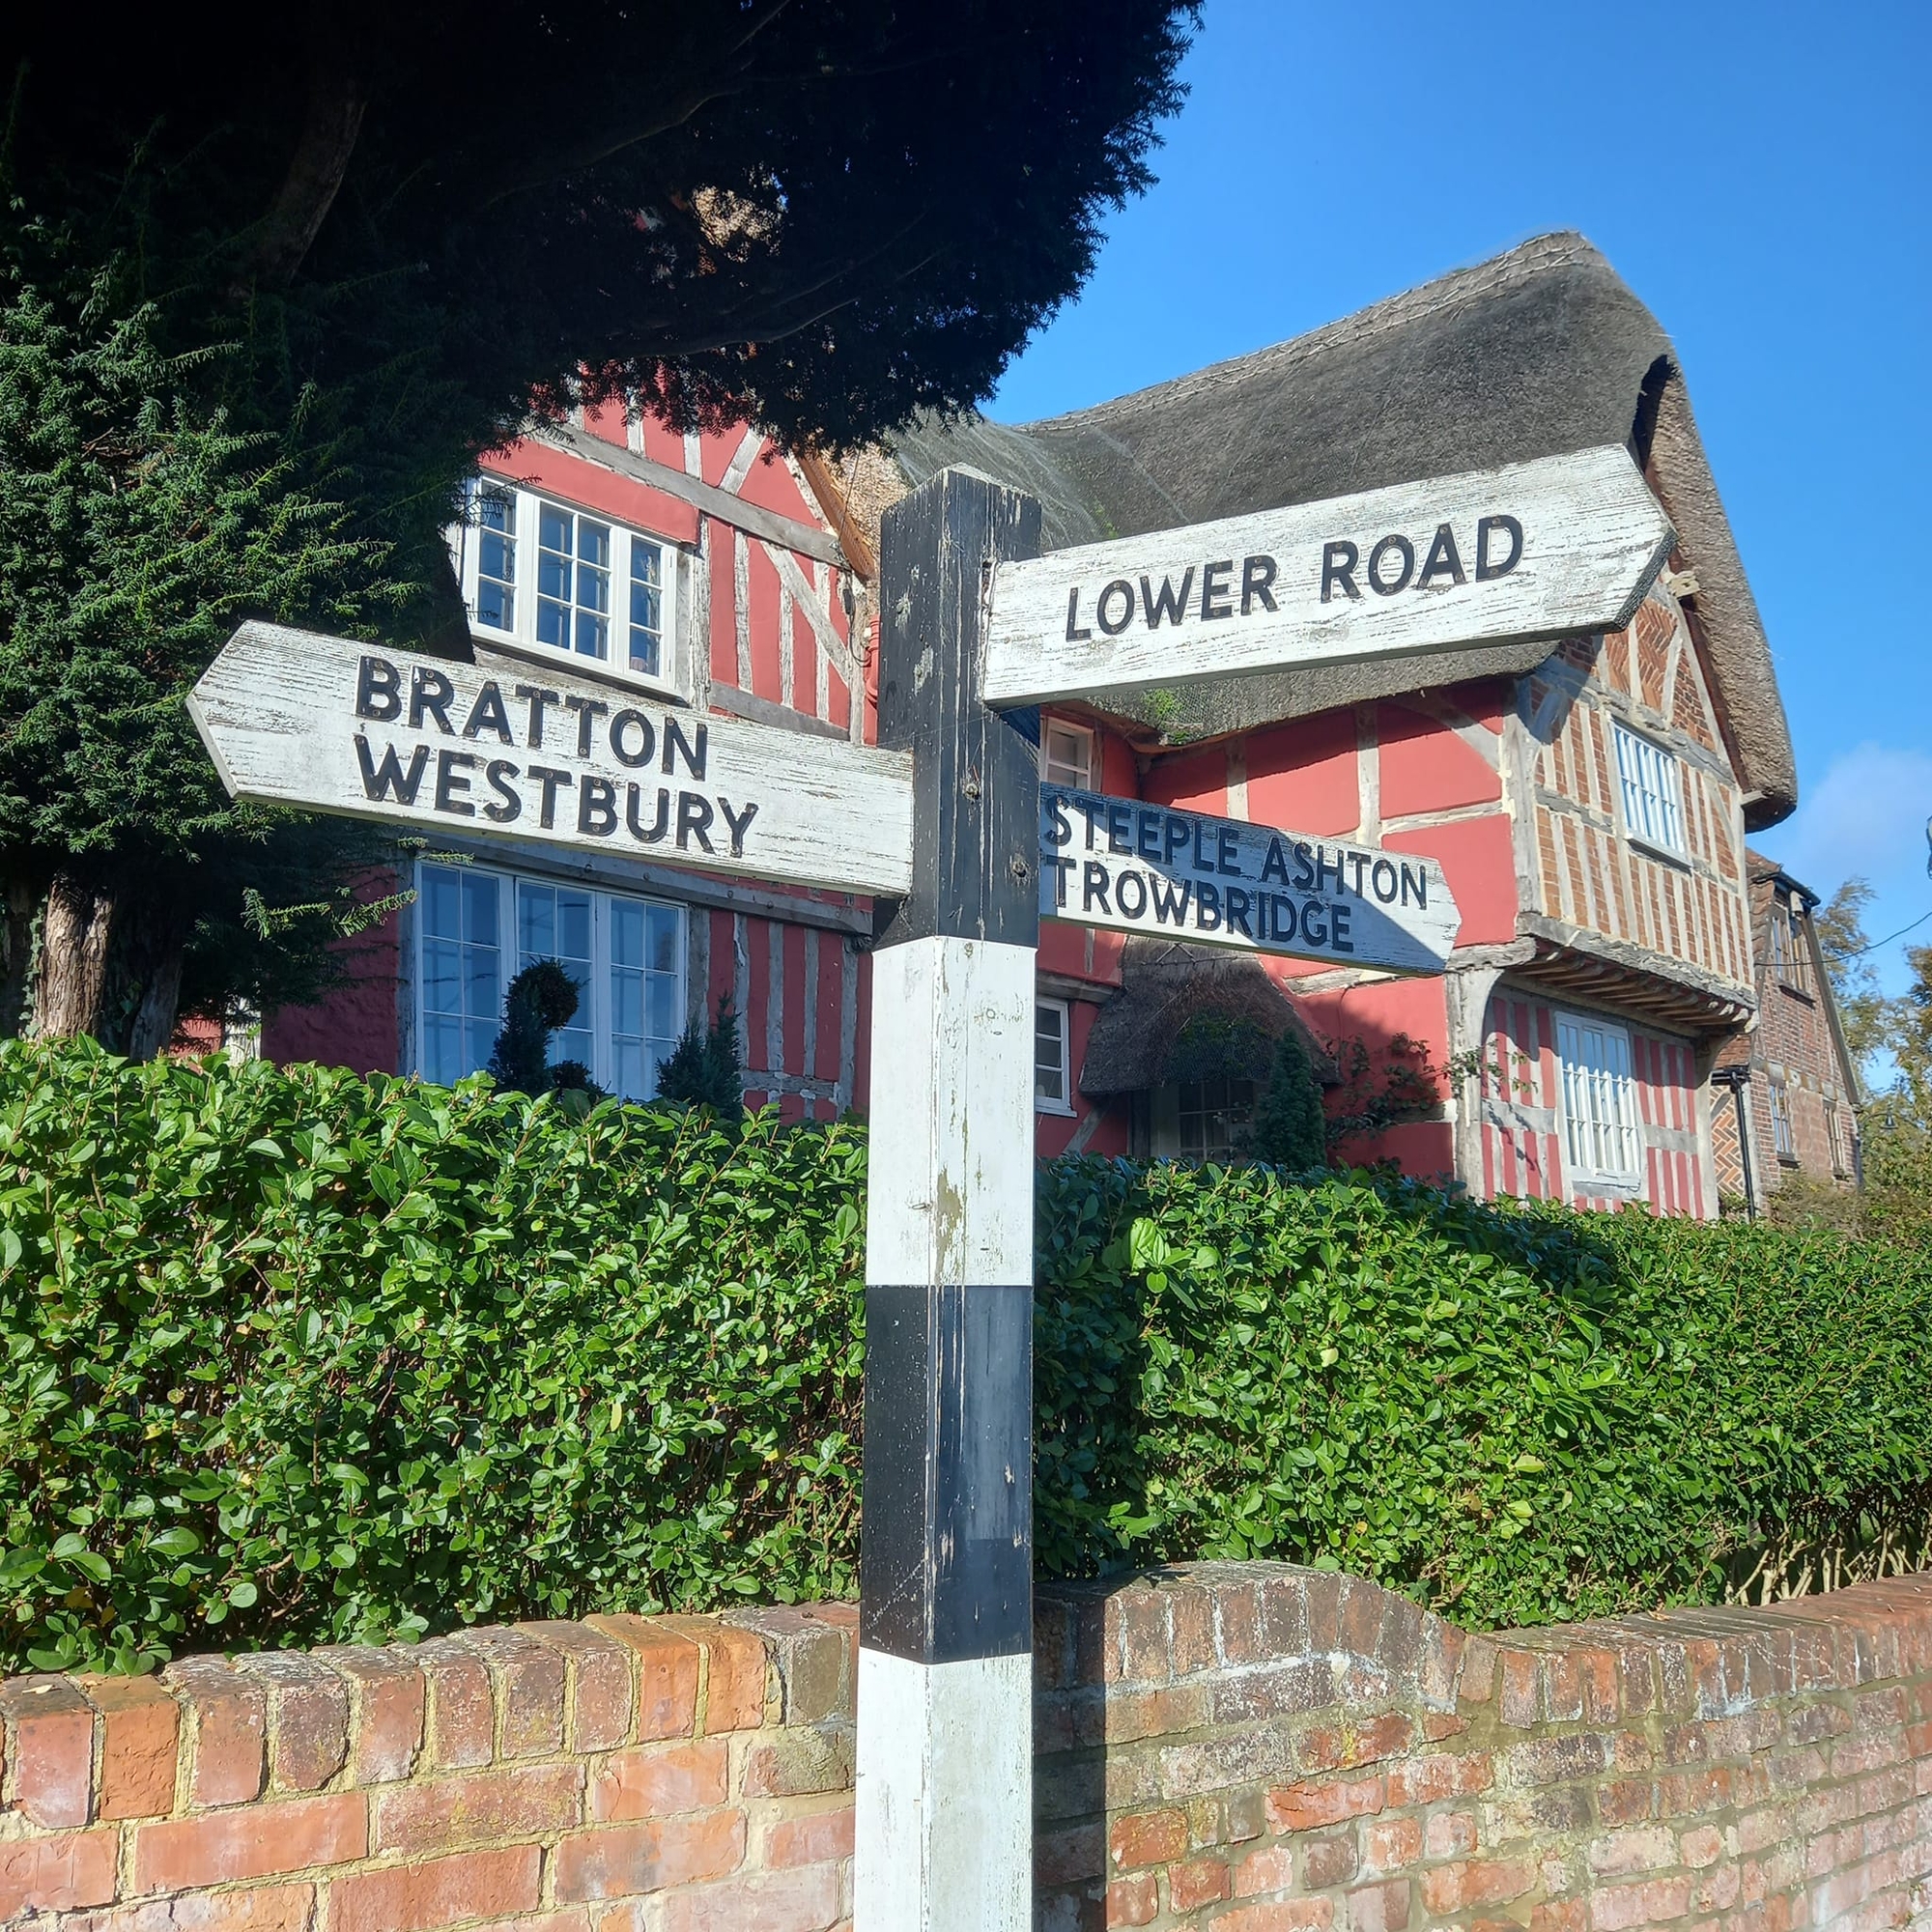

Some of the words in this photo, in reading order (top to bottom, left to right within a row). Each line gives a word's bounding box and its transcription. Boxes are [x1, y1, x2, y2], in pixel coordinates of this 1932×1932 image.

[1065, 554, 1279, 641] LOWER
[1321, 514, 1524, 604] ROAD
[356, 656, 708, 781] BRATTON
[354, 734, 758, 858] WESTBURY
[1045, 795, 1241, 875] STEEPLE
[1262, 838, 1427, 910] ASHTON
[1045, 855, 1354, 952] TROWBRIDGE
